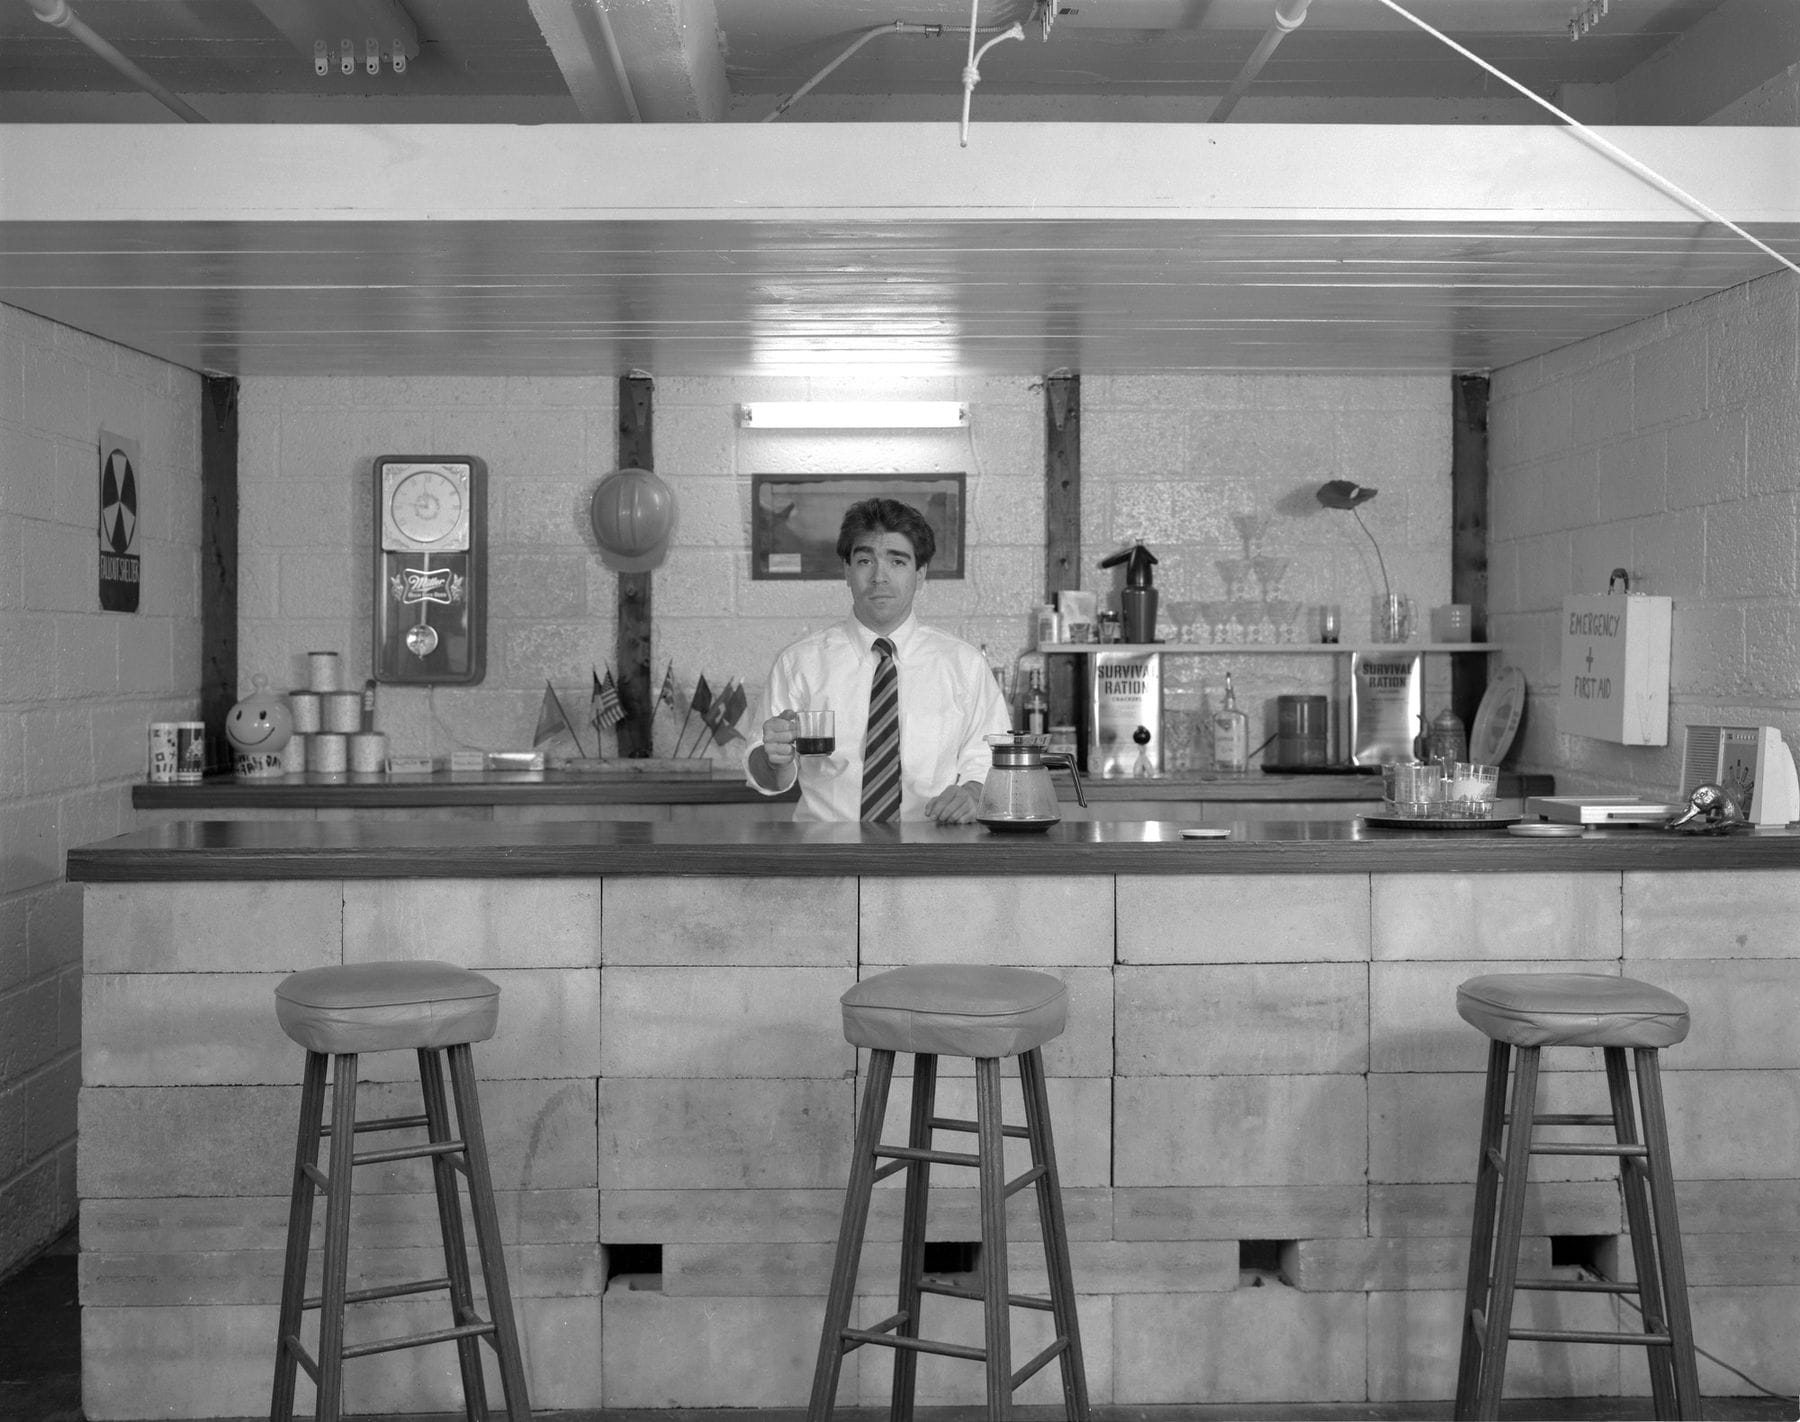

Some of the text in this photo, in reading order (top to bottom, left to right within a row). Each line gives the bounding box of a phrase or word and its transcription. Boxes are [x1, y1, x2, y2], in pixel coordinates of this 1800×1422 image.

[120, 557, 140, 583] SHELTER
[408, 575, 446, 591] Miller
[1569, 612, 1620, 638] EMERGENCY
[1098, 664, 1158, 678] SURVIVA
[1362, 663, 1412, 675] SURVIVAL
[1369, 676, 1407, 688] RATION
[1574, 675, 1612, 699] FIRST AID
